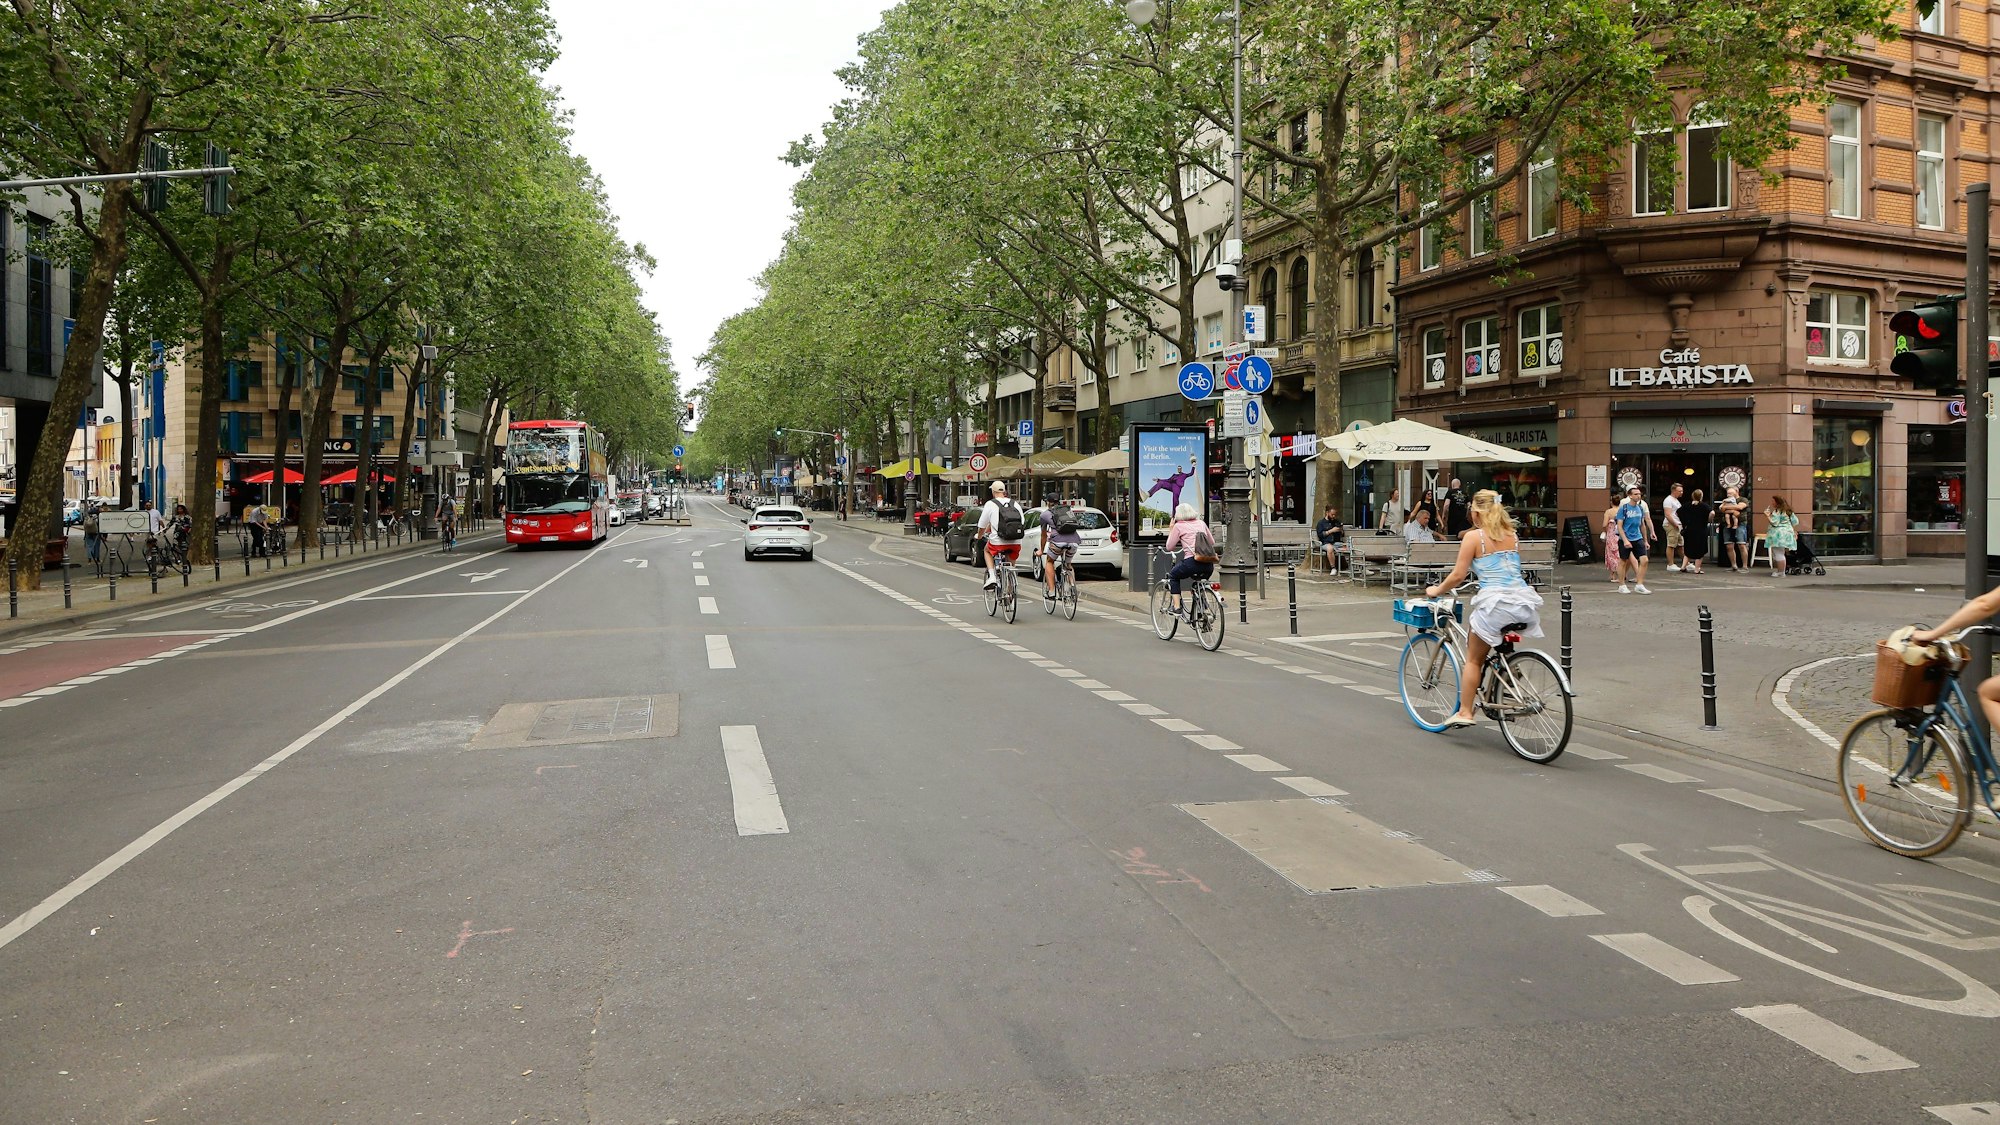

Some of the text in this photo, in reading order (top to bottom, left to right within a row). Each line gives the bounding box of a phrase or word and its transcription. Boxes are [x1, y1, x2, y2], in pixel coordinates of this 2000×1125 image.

[1659, 348, 1700, 364] Café
[1610, 364, 1754, 386] IL BARISTA
[1292, 431, 1317, 457] DÖNER
[1495, 433, 1503, 444] IL
[1506, 430, 1548, 443] BARISTA
[973, 458, 984, 467] 30
